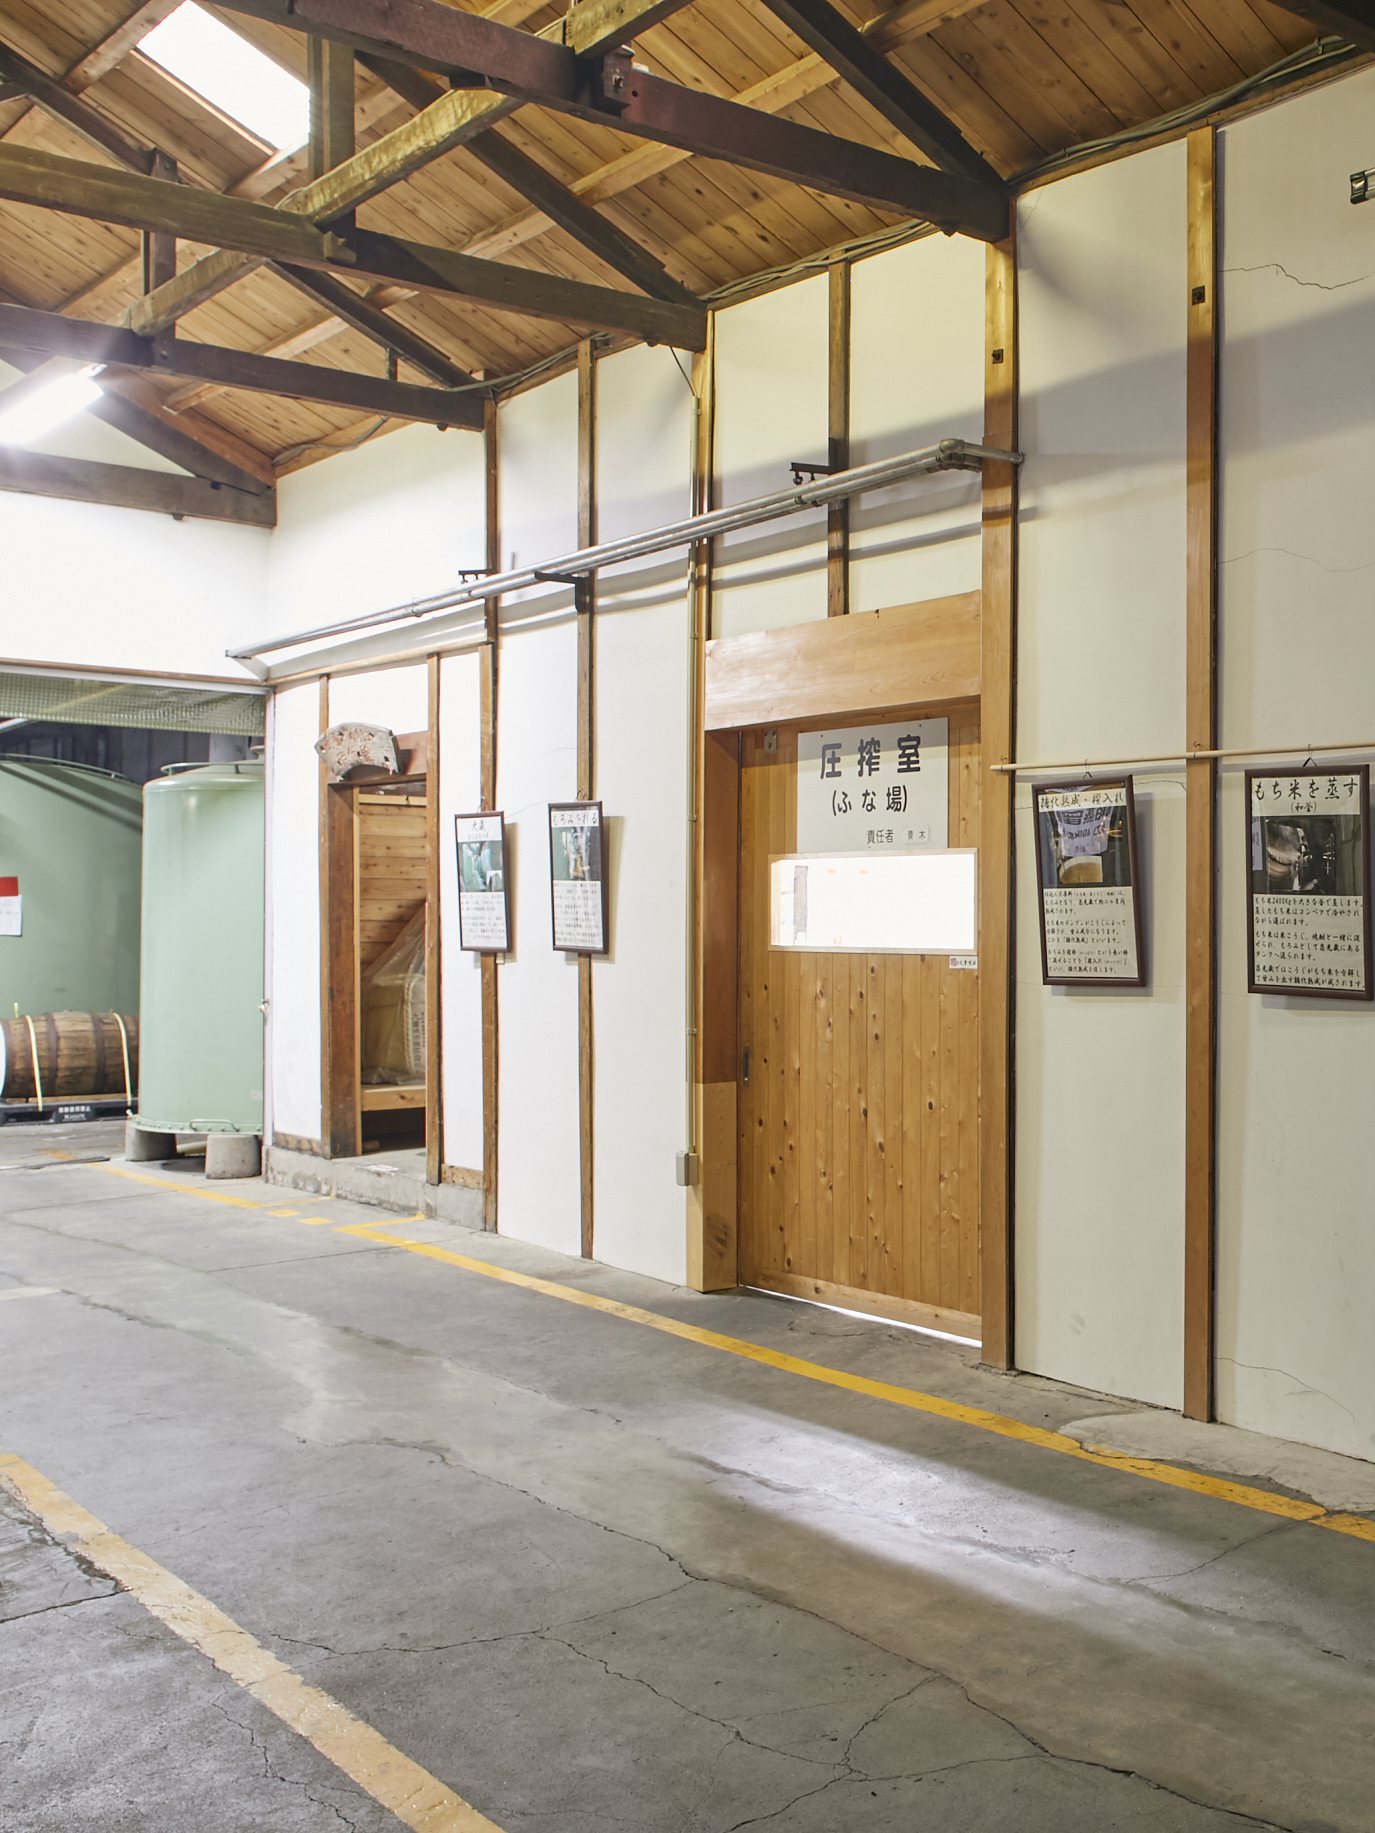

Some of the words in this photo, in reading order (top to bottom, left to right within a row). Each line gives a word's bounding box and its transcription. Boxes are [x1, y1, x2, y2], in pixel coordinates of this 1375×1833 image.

[820, 734, 921, 780] 圧搾室
[832, 785, 908, 817] (ふな場)
[1254, 777, 1359, 801] もち米を蒸す
[867, 828, 894, 844] 責任者
